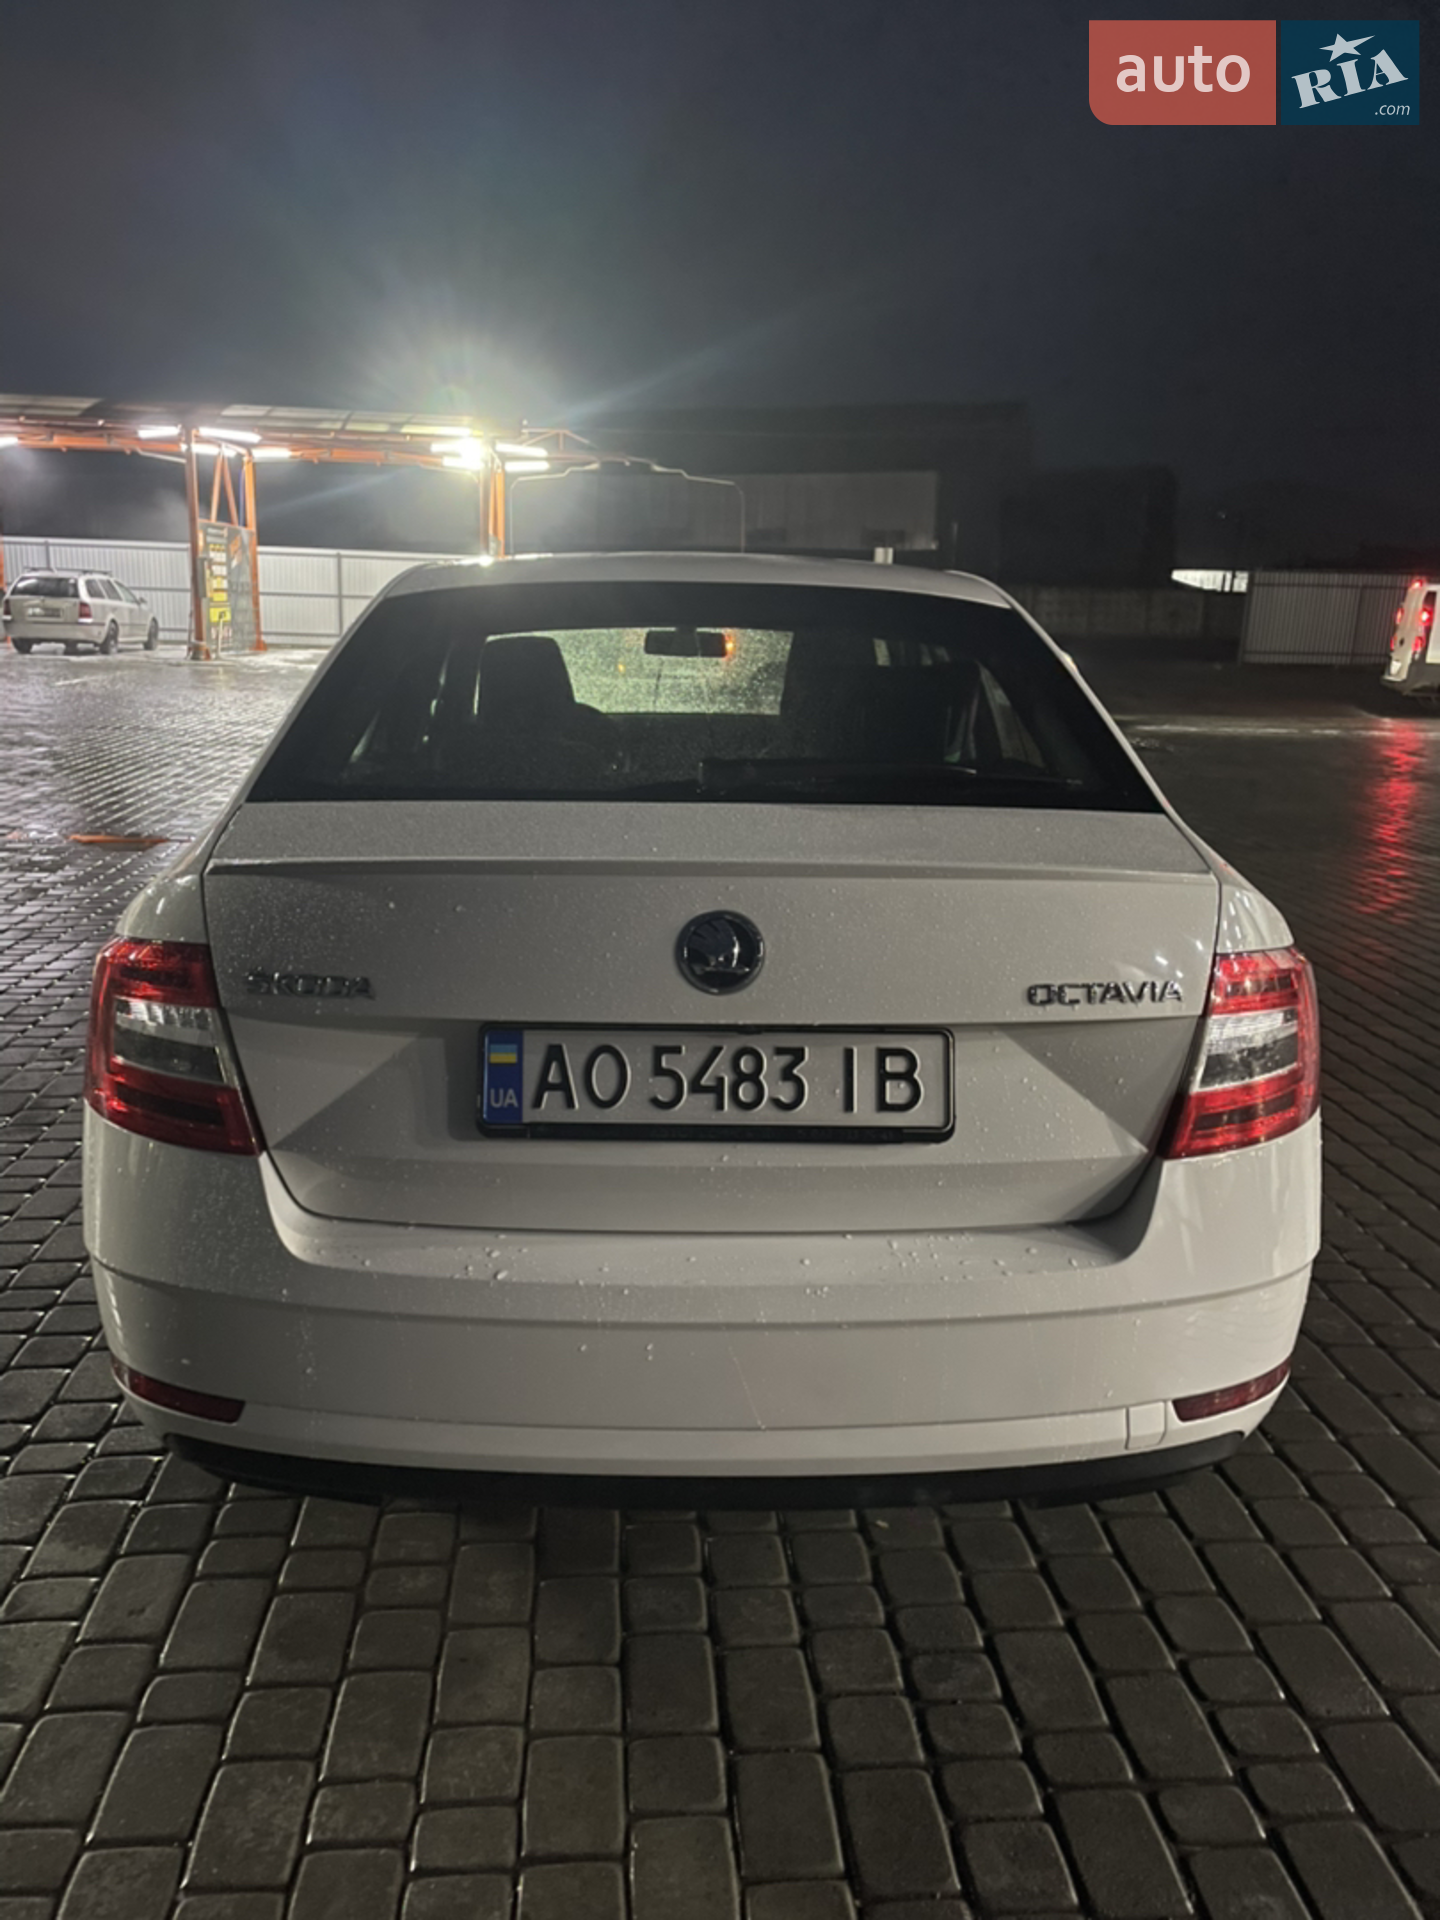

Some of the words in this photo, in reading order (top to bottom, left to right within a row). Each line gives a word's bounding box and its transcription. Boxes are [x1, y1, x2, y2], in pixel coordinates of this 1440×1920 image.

[1027, 981, 1183, 1006] OCTAVIA
[532, 1044, 632, 1109] AO
[650, 1045, 808, 1112] 5483
[842, 1047, 924, 1113] IB
[490, 1087, 518, 1108] UA
